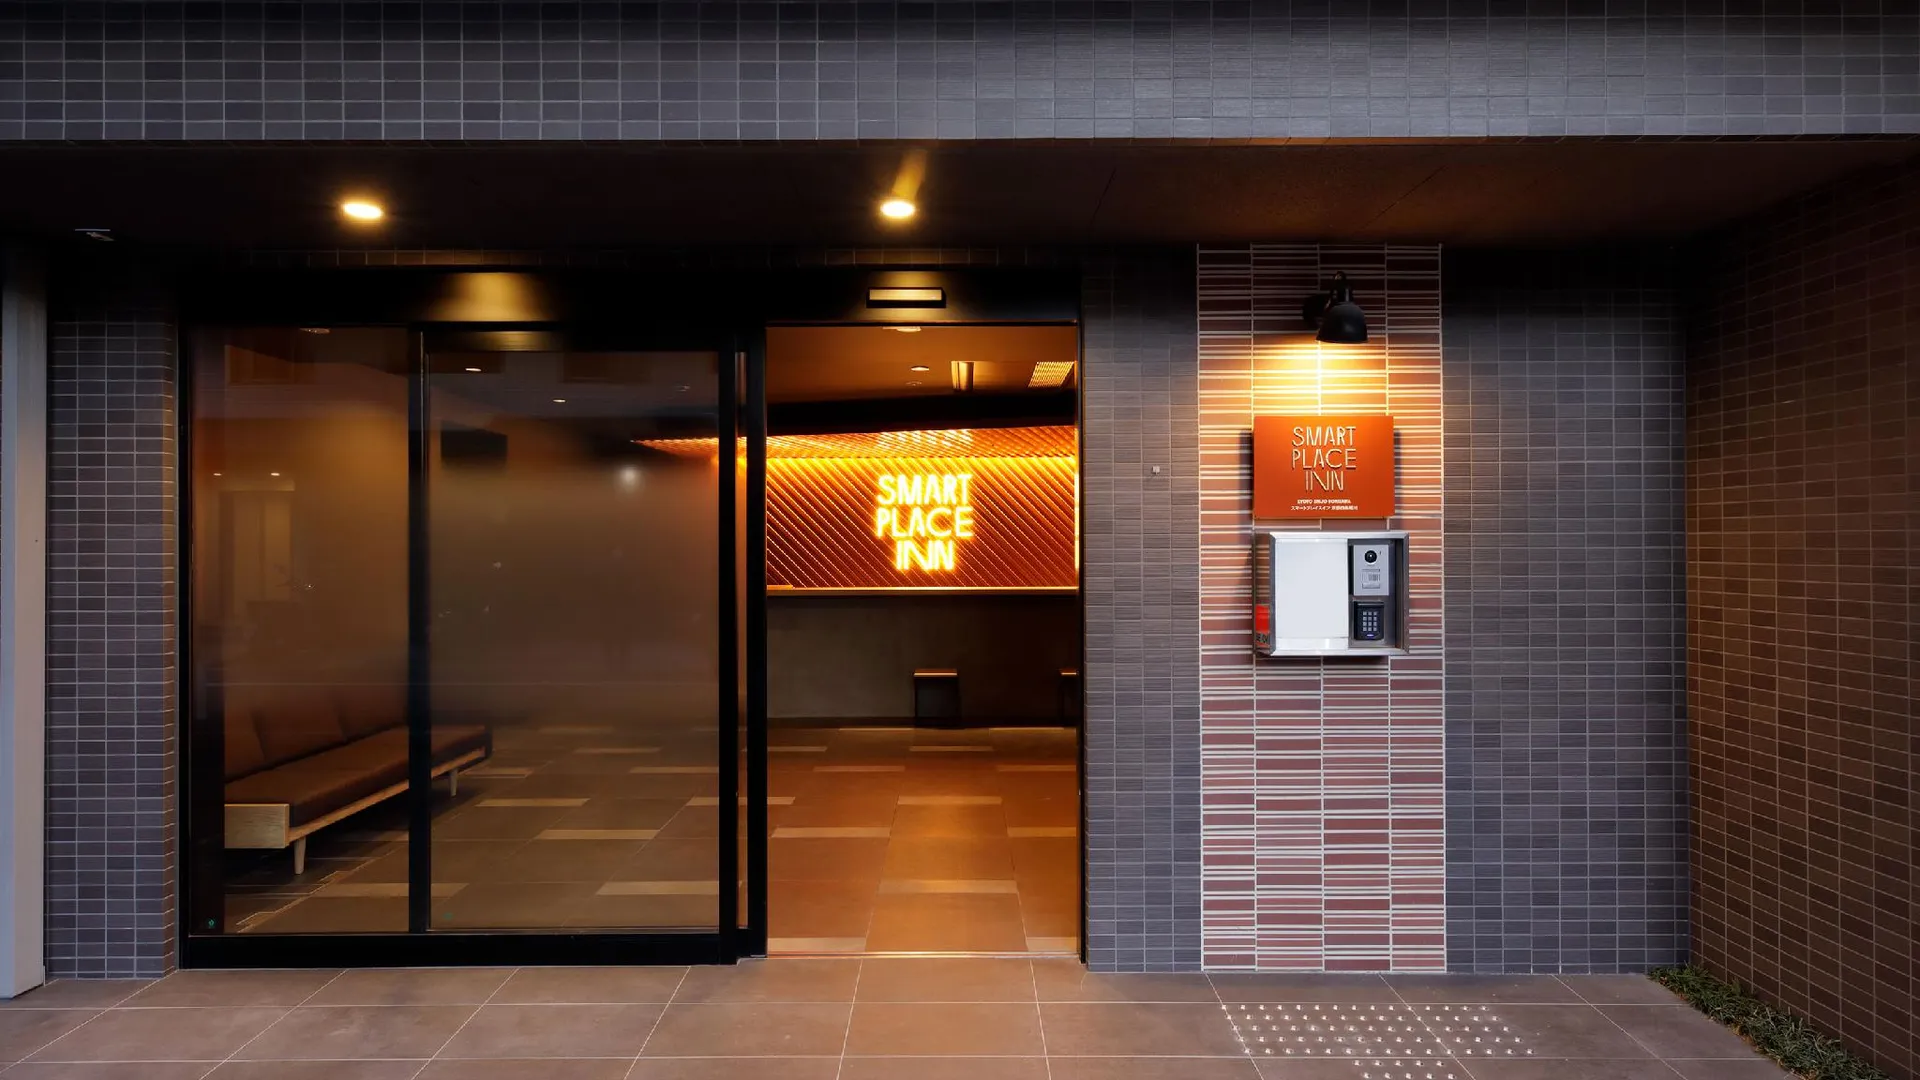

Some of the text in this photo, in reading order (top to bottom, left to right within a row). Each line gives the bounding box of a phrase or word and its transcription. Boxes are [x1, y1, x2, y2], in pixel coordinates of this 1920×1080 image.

[1292, 426, 1356, 446] SMART
[1292, 449, 1356, 468] PLACE
[877, 474, 973, 505] SMART
[1306, 470, 1344, 491] INN
[877, 506, 974, 537] PLACE
[896, 539, 953, 570] INN
